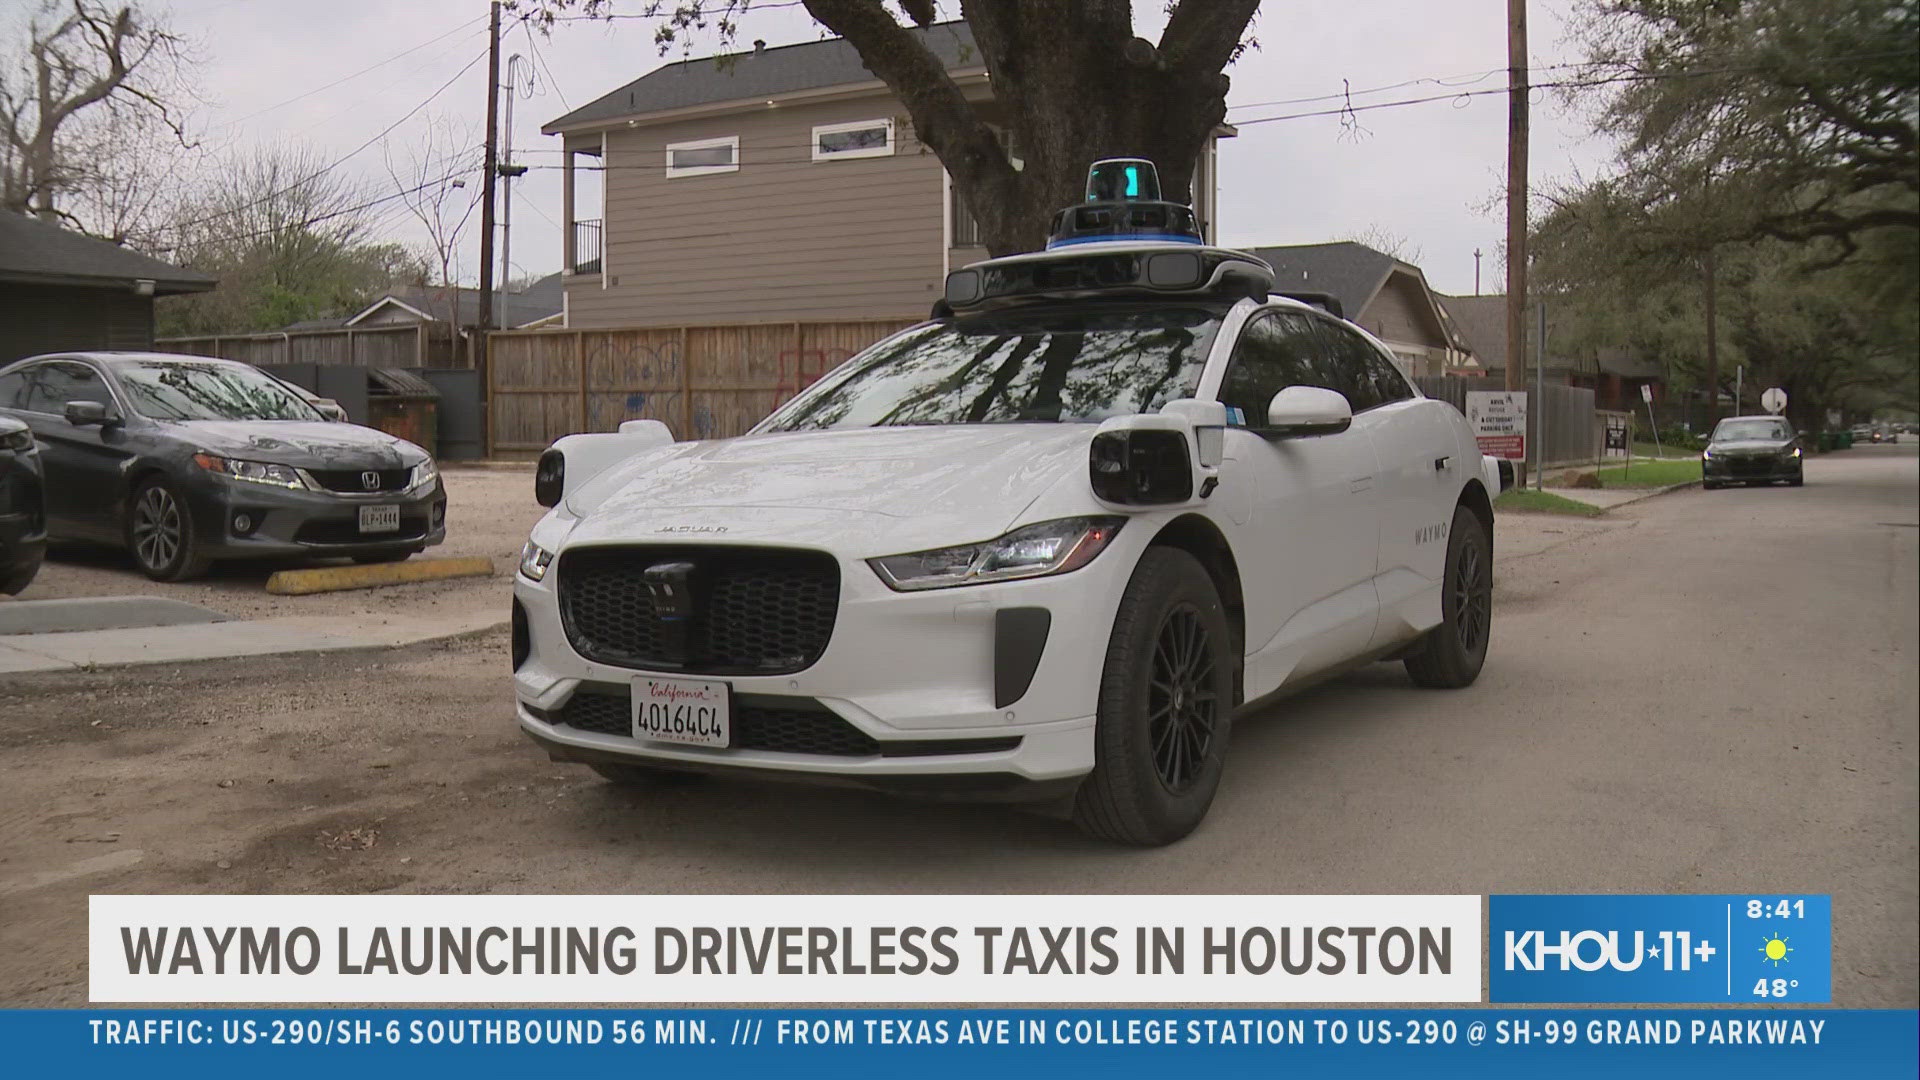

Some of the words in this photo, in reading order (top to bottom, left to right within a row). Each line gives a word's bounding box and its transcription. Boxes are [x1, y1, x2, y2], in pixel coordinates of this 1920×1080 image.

[1415, 521, 1447, 545] WAYMO
[651, 682, 709, 703] California
[638, 702, 722, 738] 40164C4
